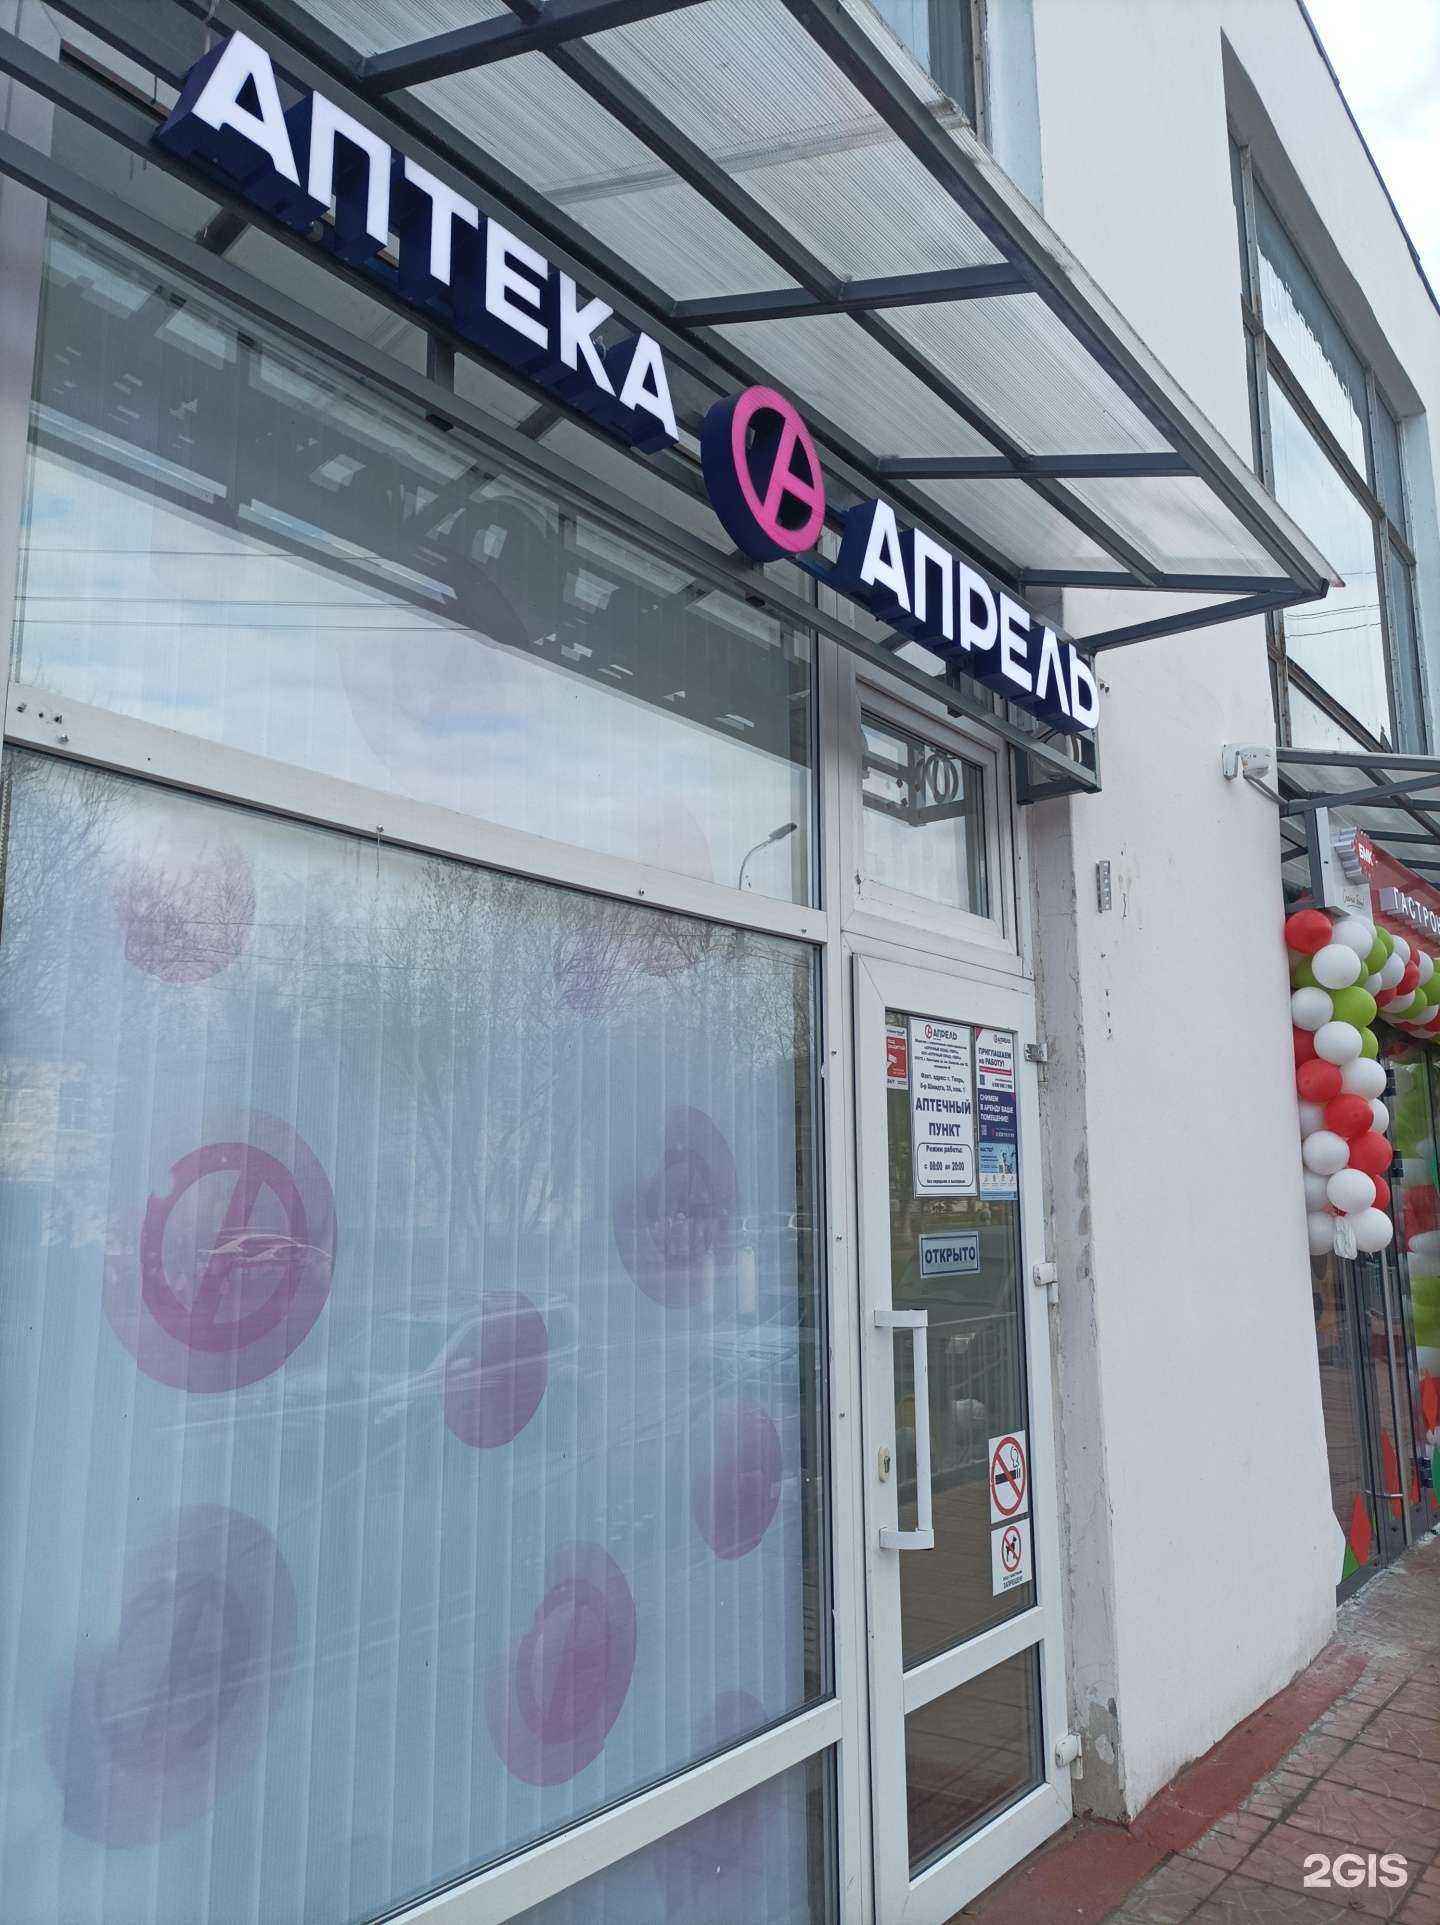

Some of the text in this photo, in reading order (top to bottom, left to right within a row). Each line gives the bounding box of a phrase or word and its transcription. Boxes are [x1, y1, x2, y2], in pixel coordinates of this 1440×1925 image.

[190, 29, 681, 441] АПТЕКА
[859, 498, 1101, 731] АПРЕЛЬ
[933, 1029, 958, 1040] АПРЕЛЬ
[978, 1048, 1012, 1060] ПРИГЛАШАЕМ
[915, 1097, 971, 1115] АПТЕЧНЫЙ
[928, 1122, 961, 1137] ПУНКТ
[925, 1246, 976, 1264] ОТКРЫТО
